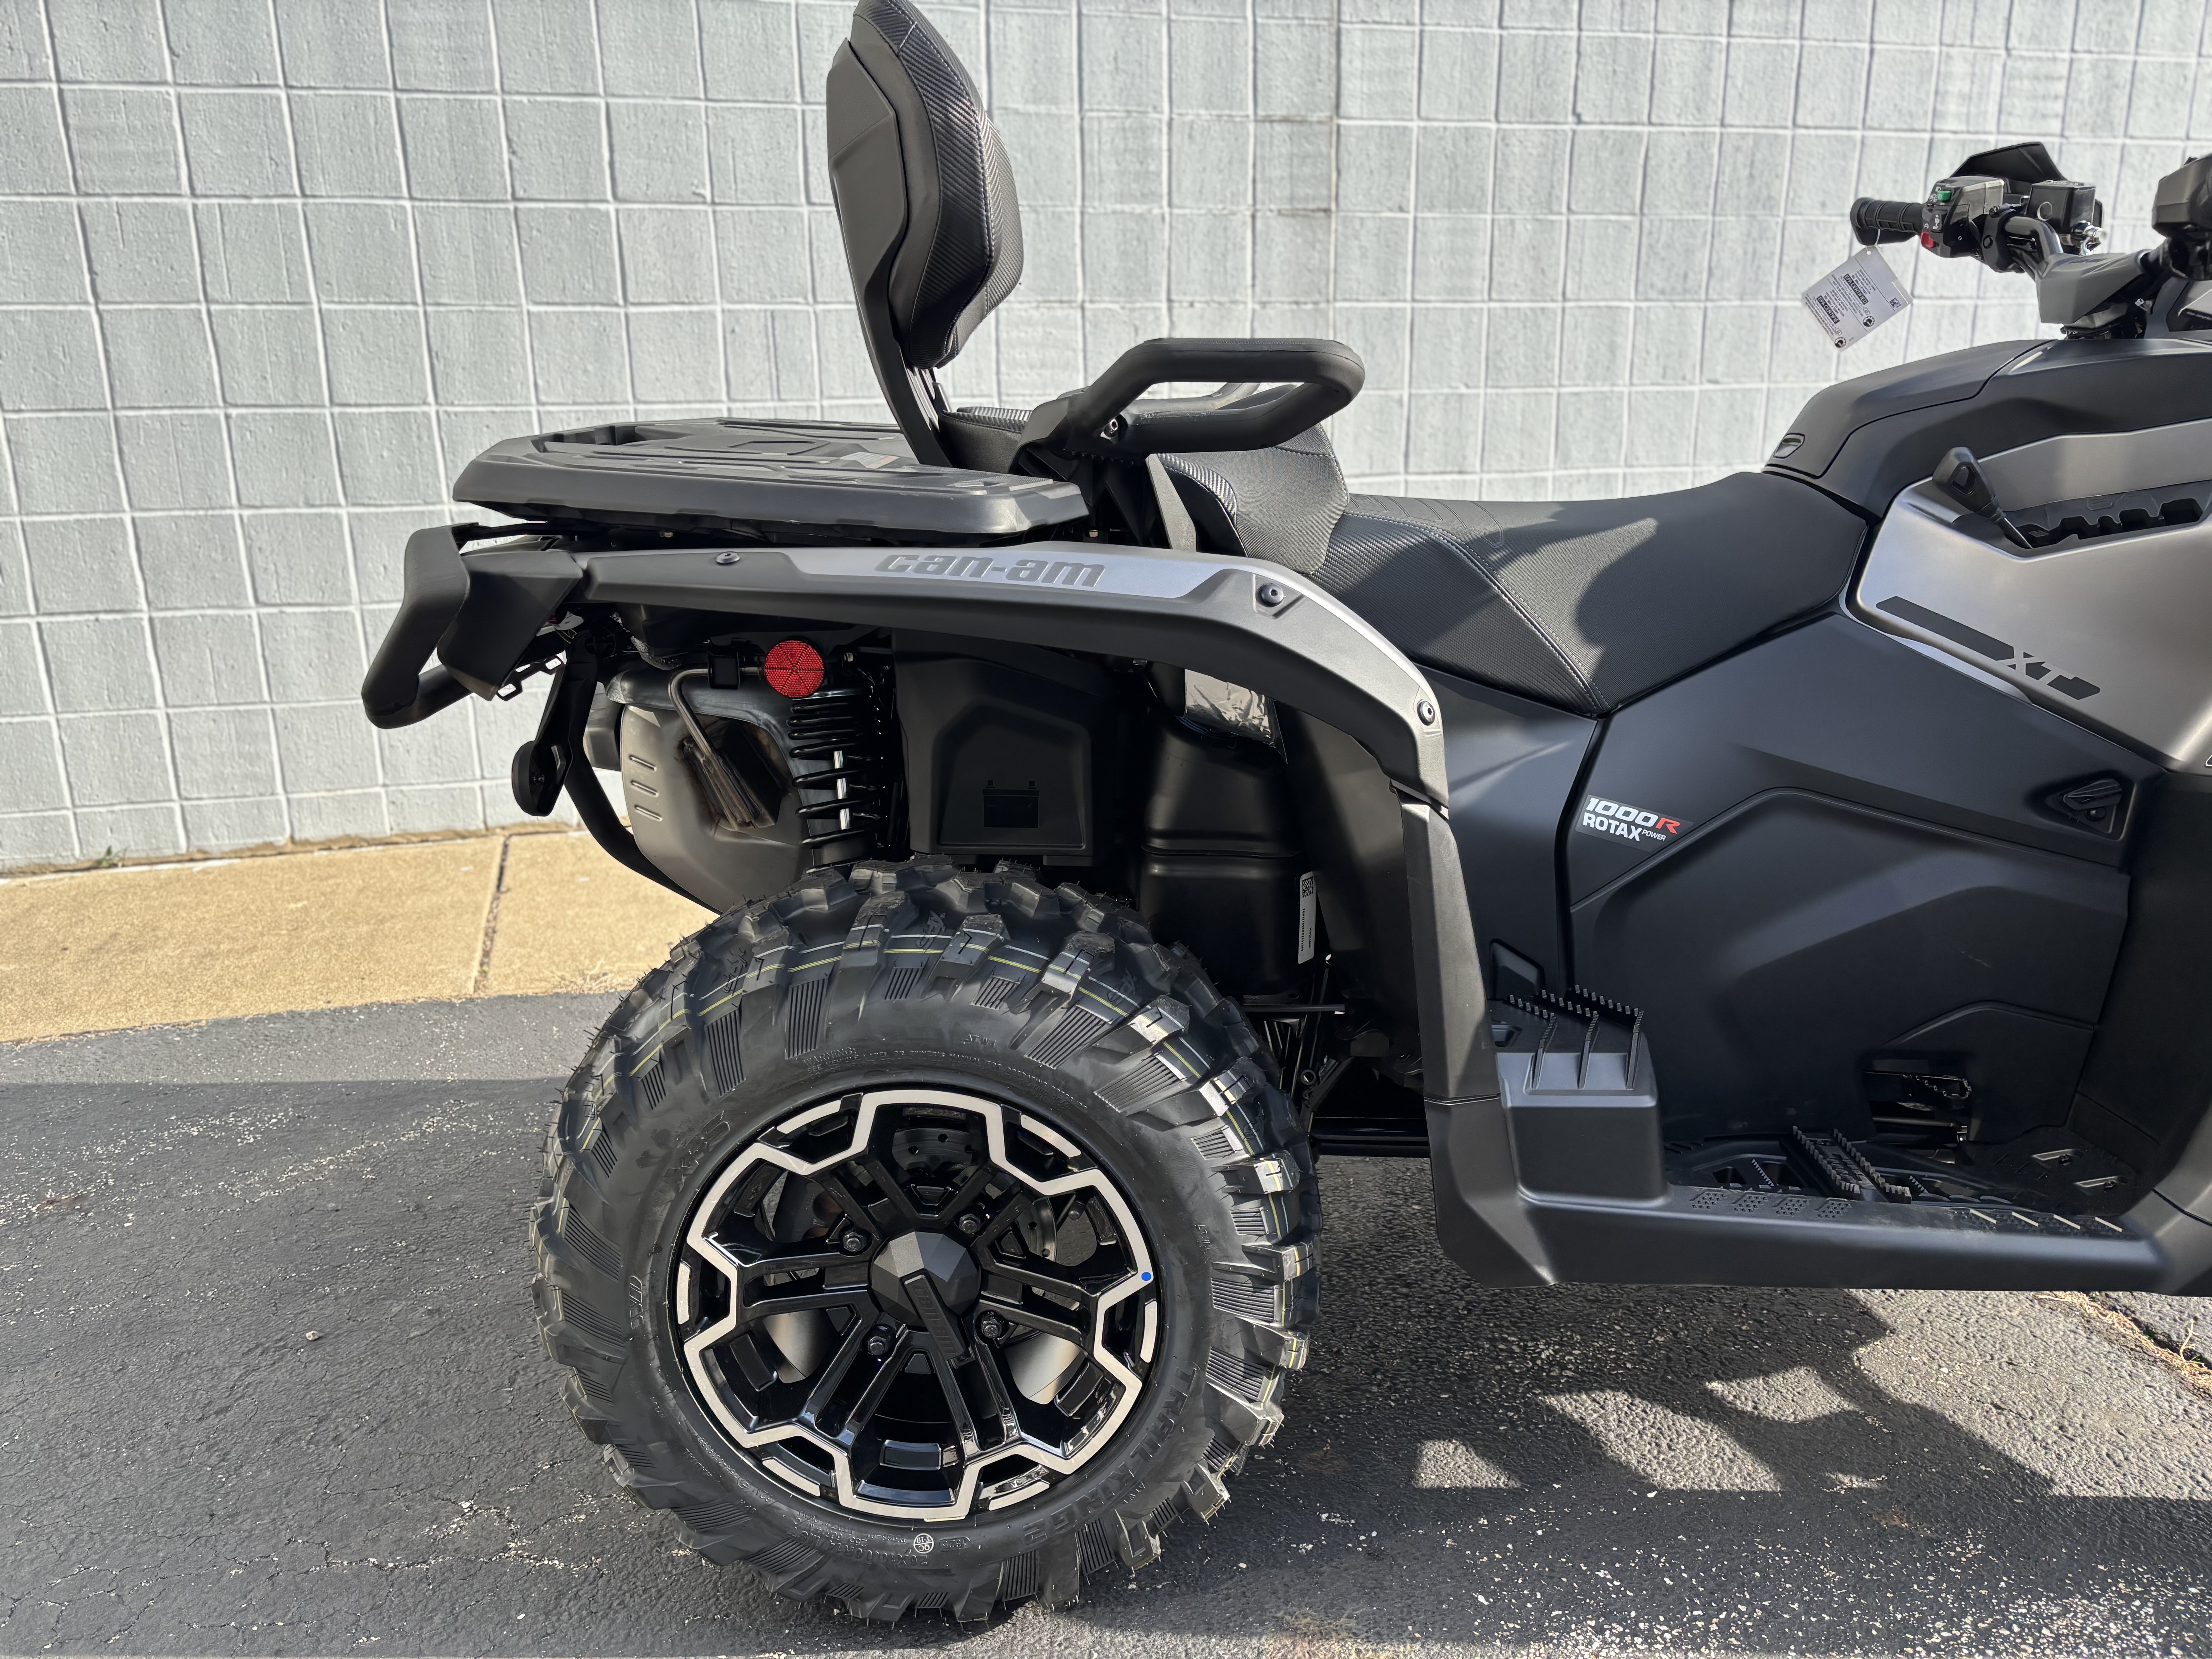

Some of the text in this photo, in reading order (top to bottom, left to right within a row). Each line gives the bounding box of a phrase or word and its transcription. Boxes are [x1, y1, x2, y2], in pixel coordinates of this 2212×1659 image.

[1817, 296, 1826, 306] EPA
[1844, 274, 1853, 284] EPA
[1850, 282, 1868, 304] CERTIFIED
[874, 554, 1105, 587] can-am
[1996, 646, 2076, 685] XT
[1583, 812, 1643, 842] ROTAX
[1586, 797, 1680, 835] 1000R
[1641, 829, 1666, 841] POWER
[803, 1046, 856, 1066] WARNING:
[807, 1063, 823, 1074] SEE
[1129, 1367, 1197, 1458] TRAIL
